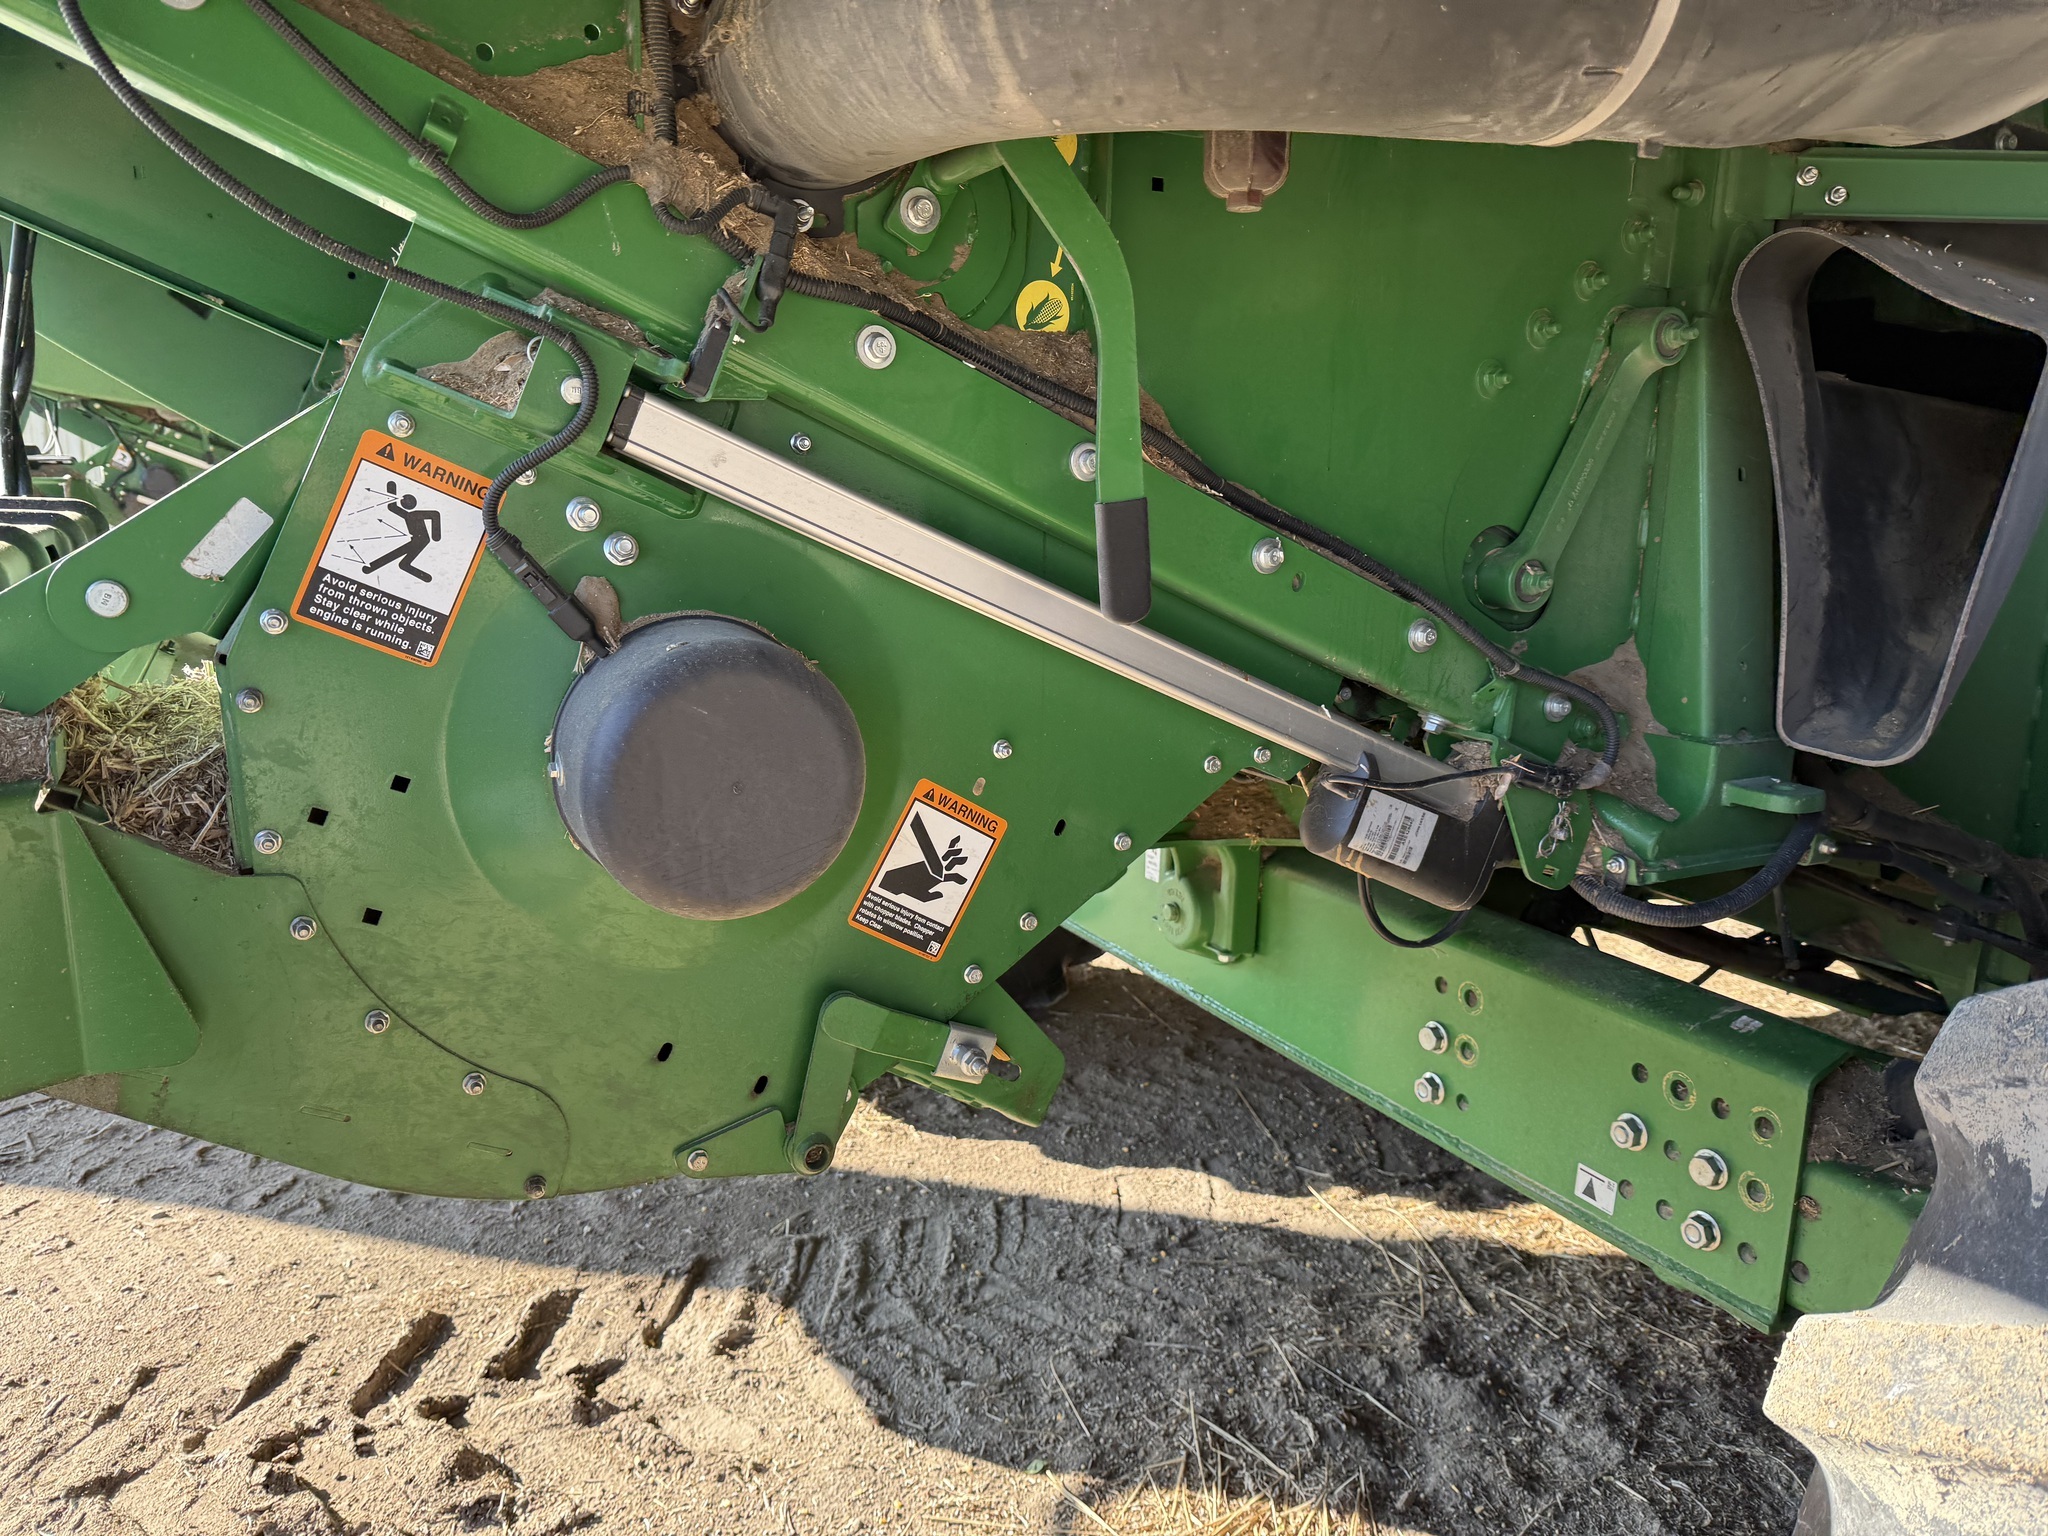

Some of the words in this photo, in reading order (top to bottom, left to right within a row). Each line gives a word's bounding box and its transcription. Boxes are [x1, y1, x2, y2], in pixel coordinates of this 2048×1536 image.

[314, 594, 341, 611] Stay
[343, 606, 372, 622] clear
[374, 617, 405, 634] while
[318, 583, 346, 601] from
[349, 595, 389, 617] thrown
[391, 612, 435, 635] objects.
[322, 573, 357, 593] Avoid
[359, 589, 402, 610] serious
[405, 603, 438, 625] injury
[309, 605, 349, 626] engine
[351, 620, 362, 631] is
[365, 628, 412, 650] running.
[938, 793, 998, 833] WARNING
[855, 914, 869, 924] Keep
[869, 920, 883, 931] Clear.
[859, 907, 877, 918] rotates
[882, 918, 904, 931] windrow
[902, 927, 924, 940] position.
[863, 900, 875, 909] with
[874, 905, 895, 918] chopper
[894, 914, 912, 926] blades.
[913, 923, 935, 936] Chopper
[866, 892, 882, 903] Avoid
[881, 900, 900, 912] serious
[900, 908, 915, 919] injury
[914, 914, 927, 924] from
[926, 920, 945, 932] contact
